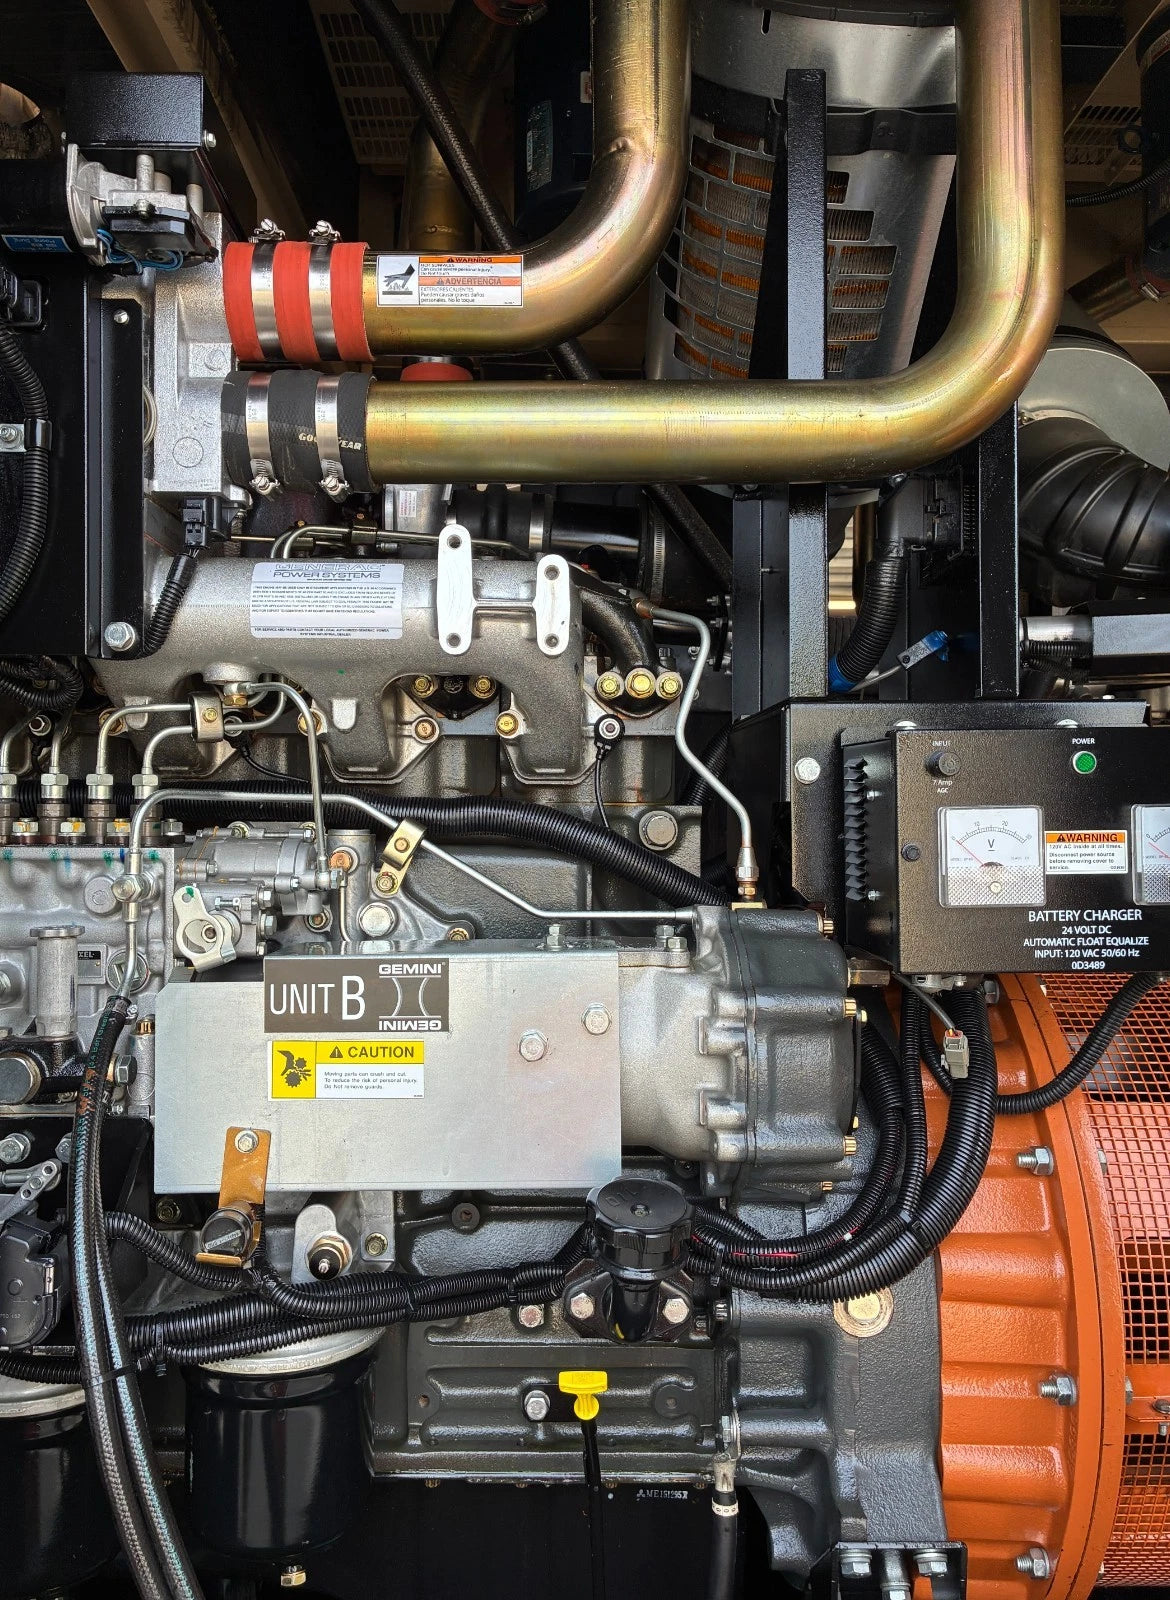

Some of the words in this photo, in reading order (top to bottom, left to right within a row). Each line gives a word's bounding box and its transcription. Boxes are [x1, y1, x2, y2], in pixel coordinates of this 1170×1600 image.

[1066, 834, 1118, 842] WARNING
[987, 839, 995, 848] V
[1028, 910, 1081, 921] BATTERY
[1084, 909, 1142, 921] CHARGER
[1062, 926, 1073, 934] 24
[1074, 926, 1097, 934] VOLT
[1099, 926, 1112, 934] DC
[1024, 938, 1075, 947] AUTOMATIC
[1077, 938, 1104, 946] FLOAT
[1106, 937, 1149, 946] EQUALIZE
[1034, 950, 1063, 958] INPUT:
[1065, 950, 1080, 958] 120
[1082, 949, 1100, 958] VAC
[1101, 949, 1126, 957] 50/60
[379, 964, 441, 975] GEMINI
[270, 983, 335, 1014] UNIT
[342, 975, 365, 1020] B
[348, 1046, 415, 1058] CAUTION
